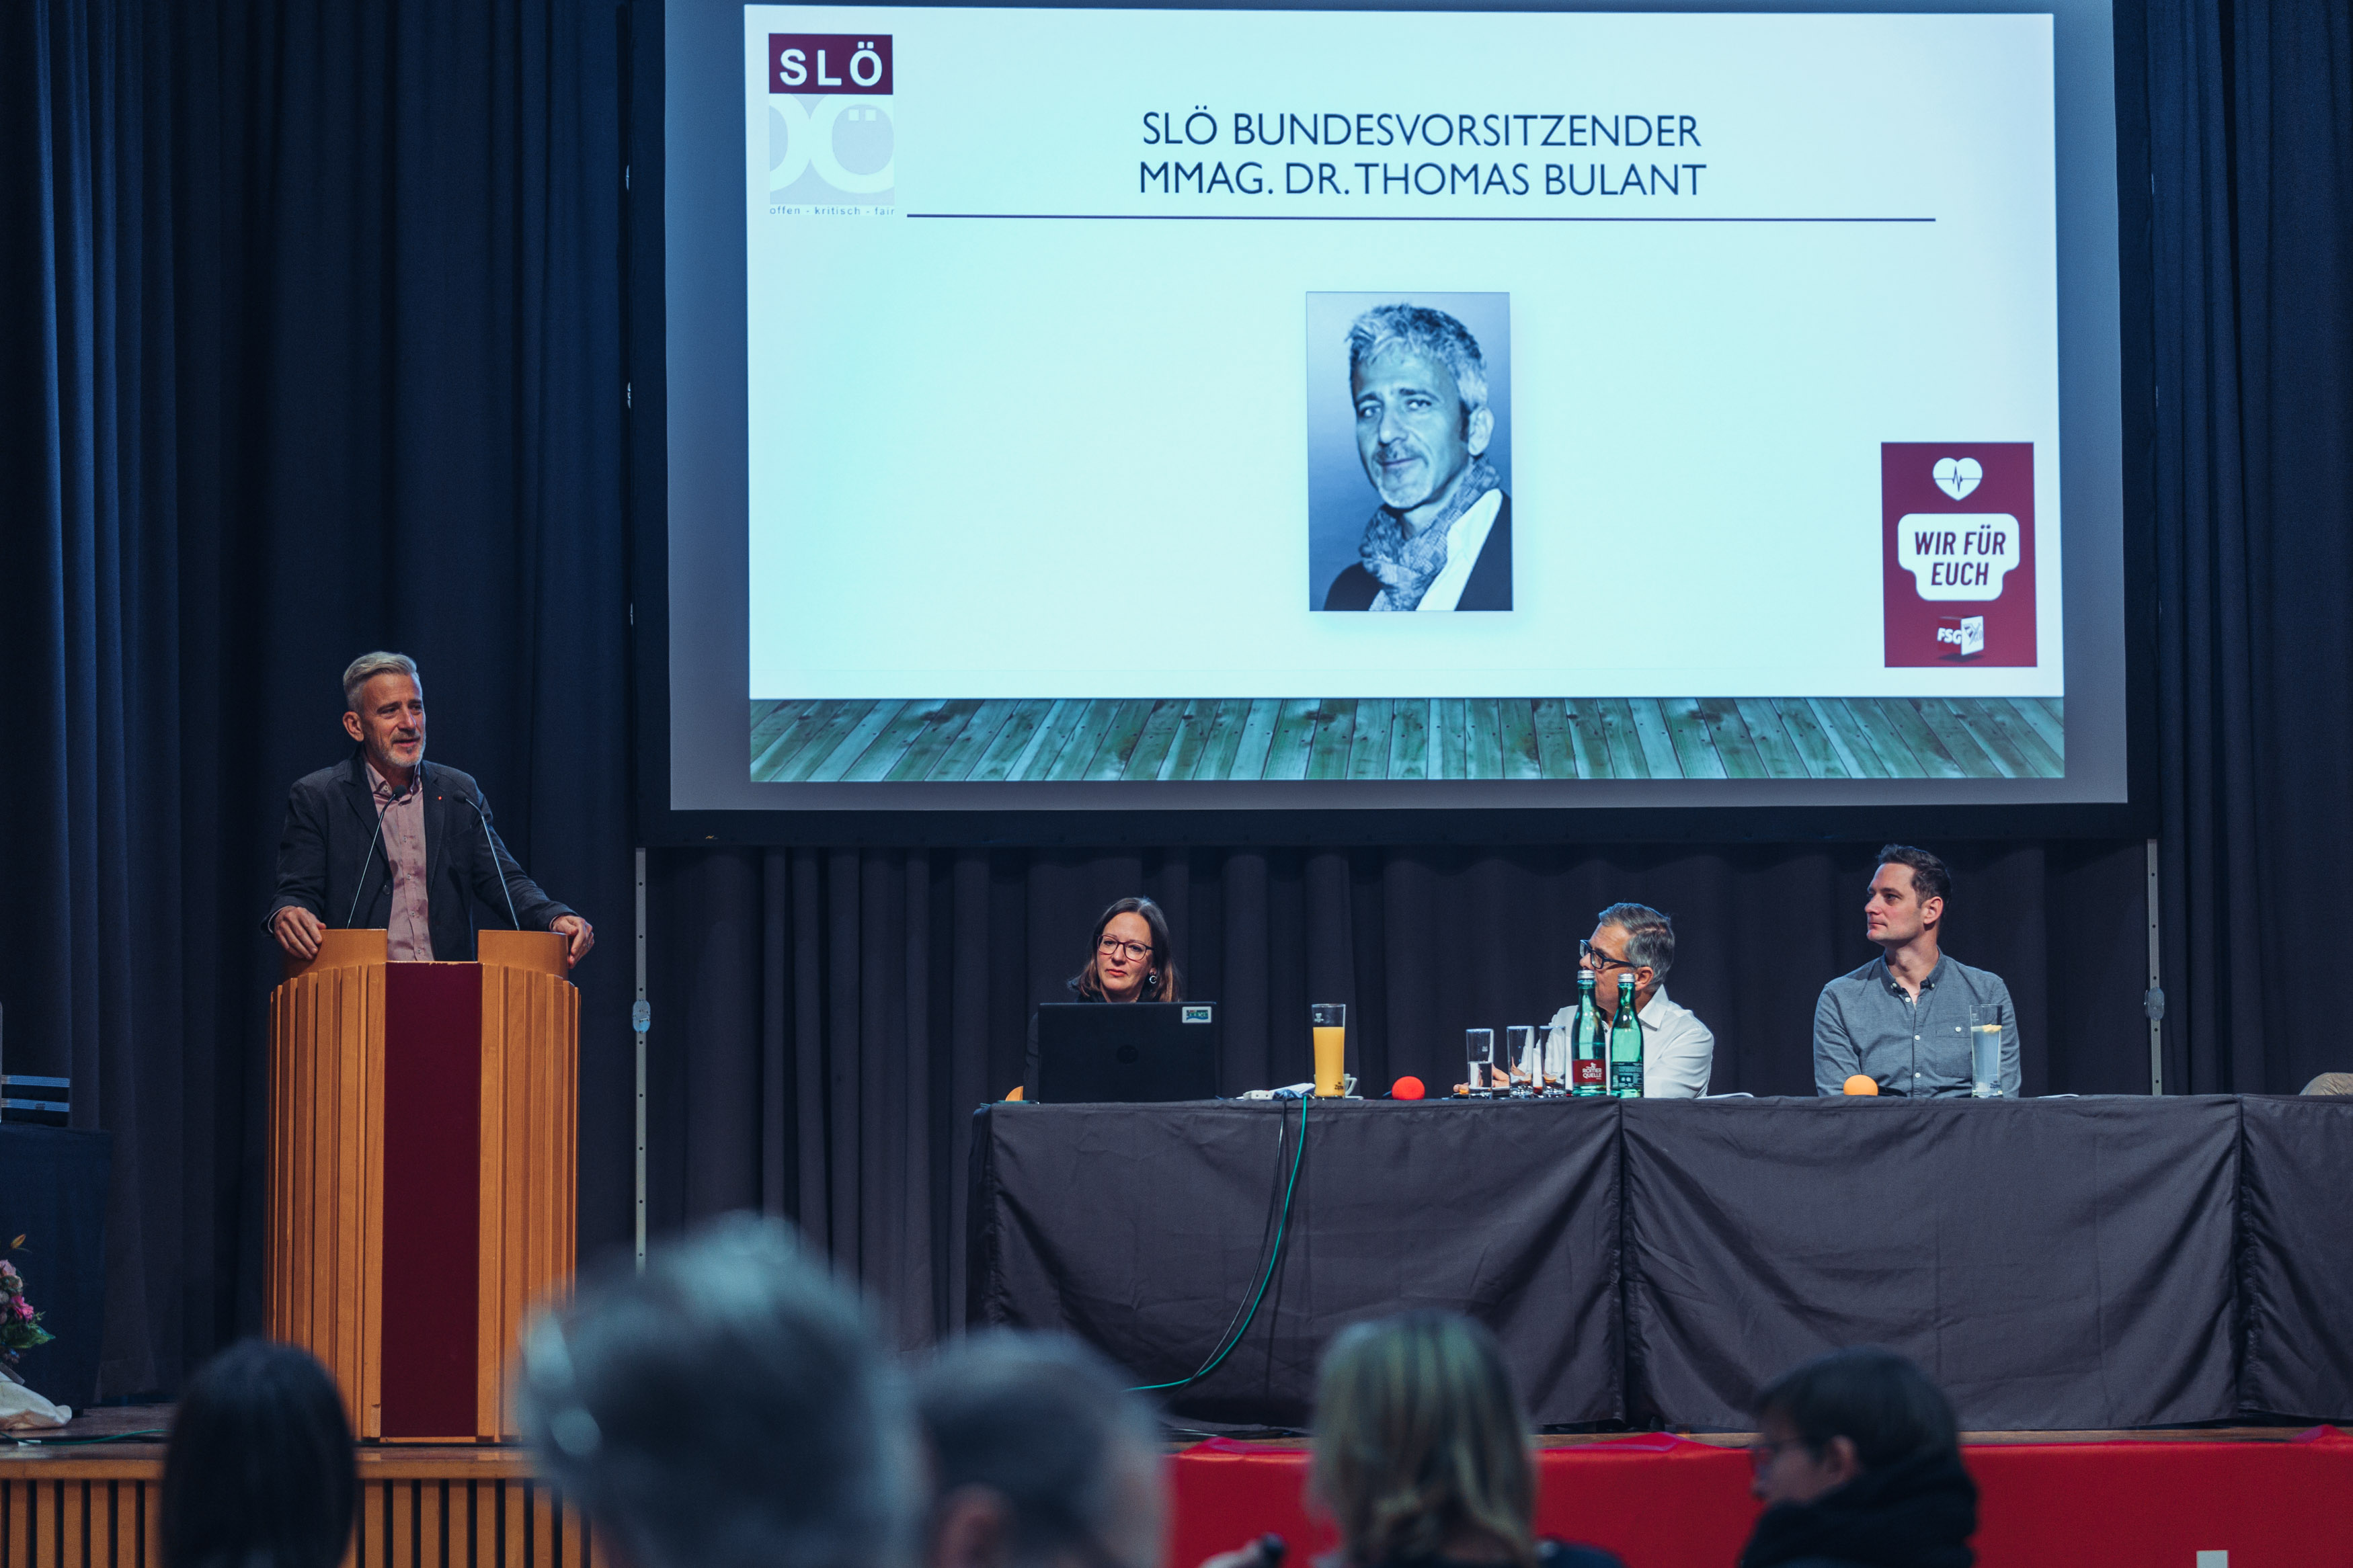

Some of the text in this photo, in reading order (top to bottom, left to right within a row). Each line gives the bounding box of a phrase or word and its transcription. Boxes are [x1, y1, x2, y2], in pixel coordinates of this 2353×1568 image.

[779, 41, 883, 87] SLÖ
[1143, 105, 1702, 147] SLÖ BUNDESVORSITZENDER
[1140, 161, 1273, 194] MMAG.
[1546, 163, 1708, 196] BULANT
[769, 206, 800, 214] offen
[814, 206, 861, 215] kritisch
[875, 206, 895, 216] fair
[1915, 524, 2006, 555] WIR FÜR
[1931, 562, 1989, 586] EUCH
[1937, 627, 1962, 645] FSG
